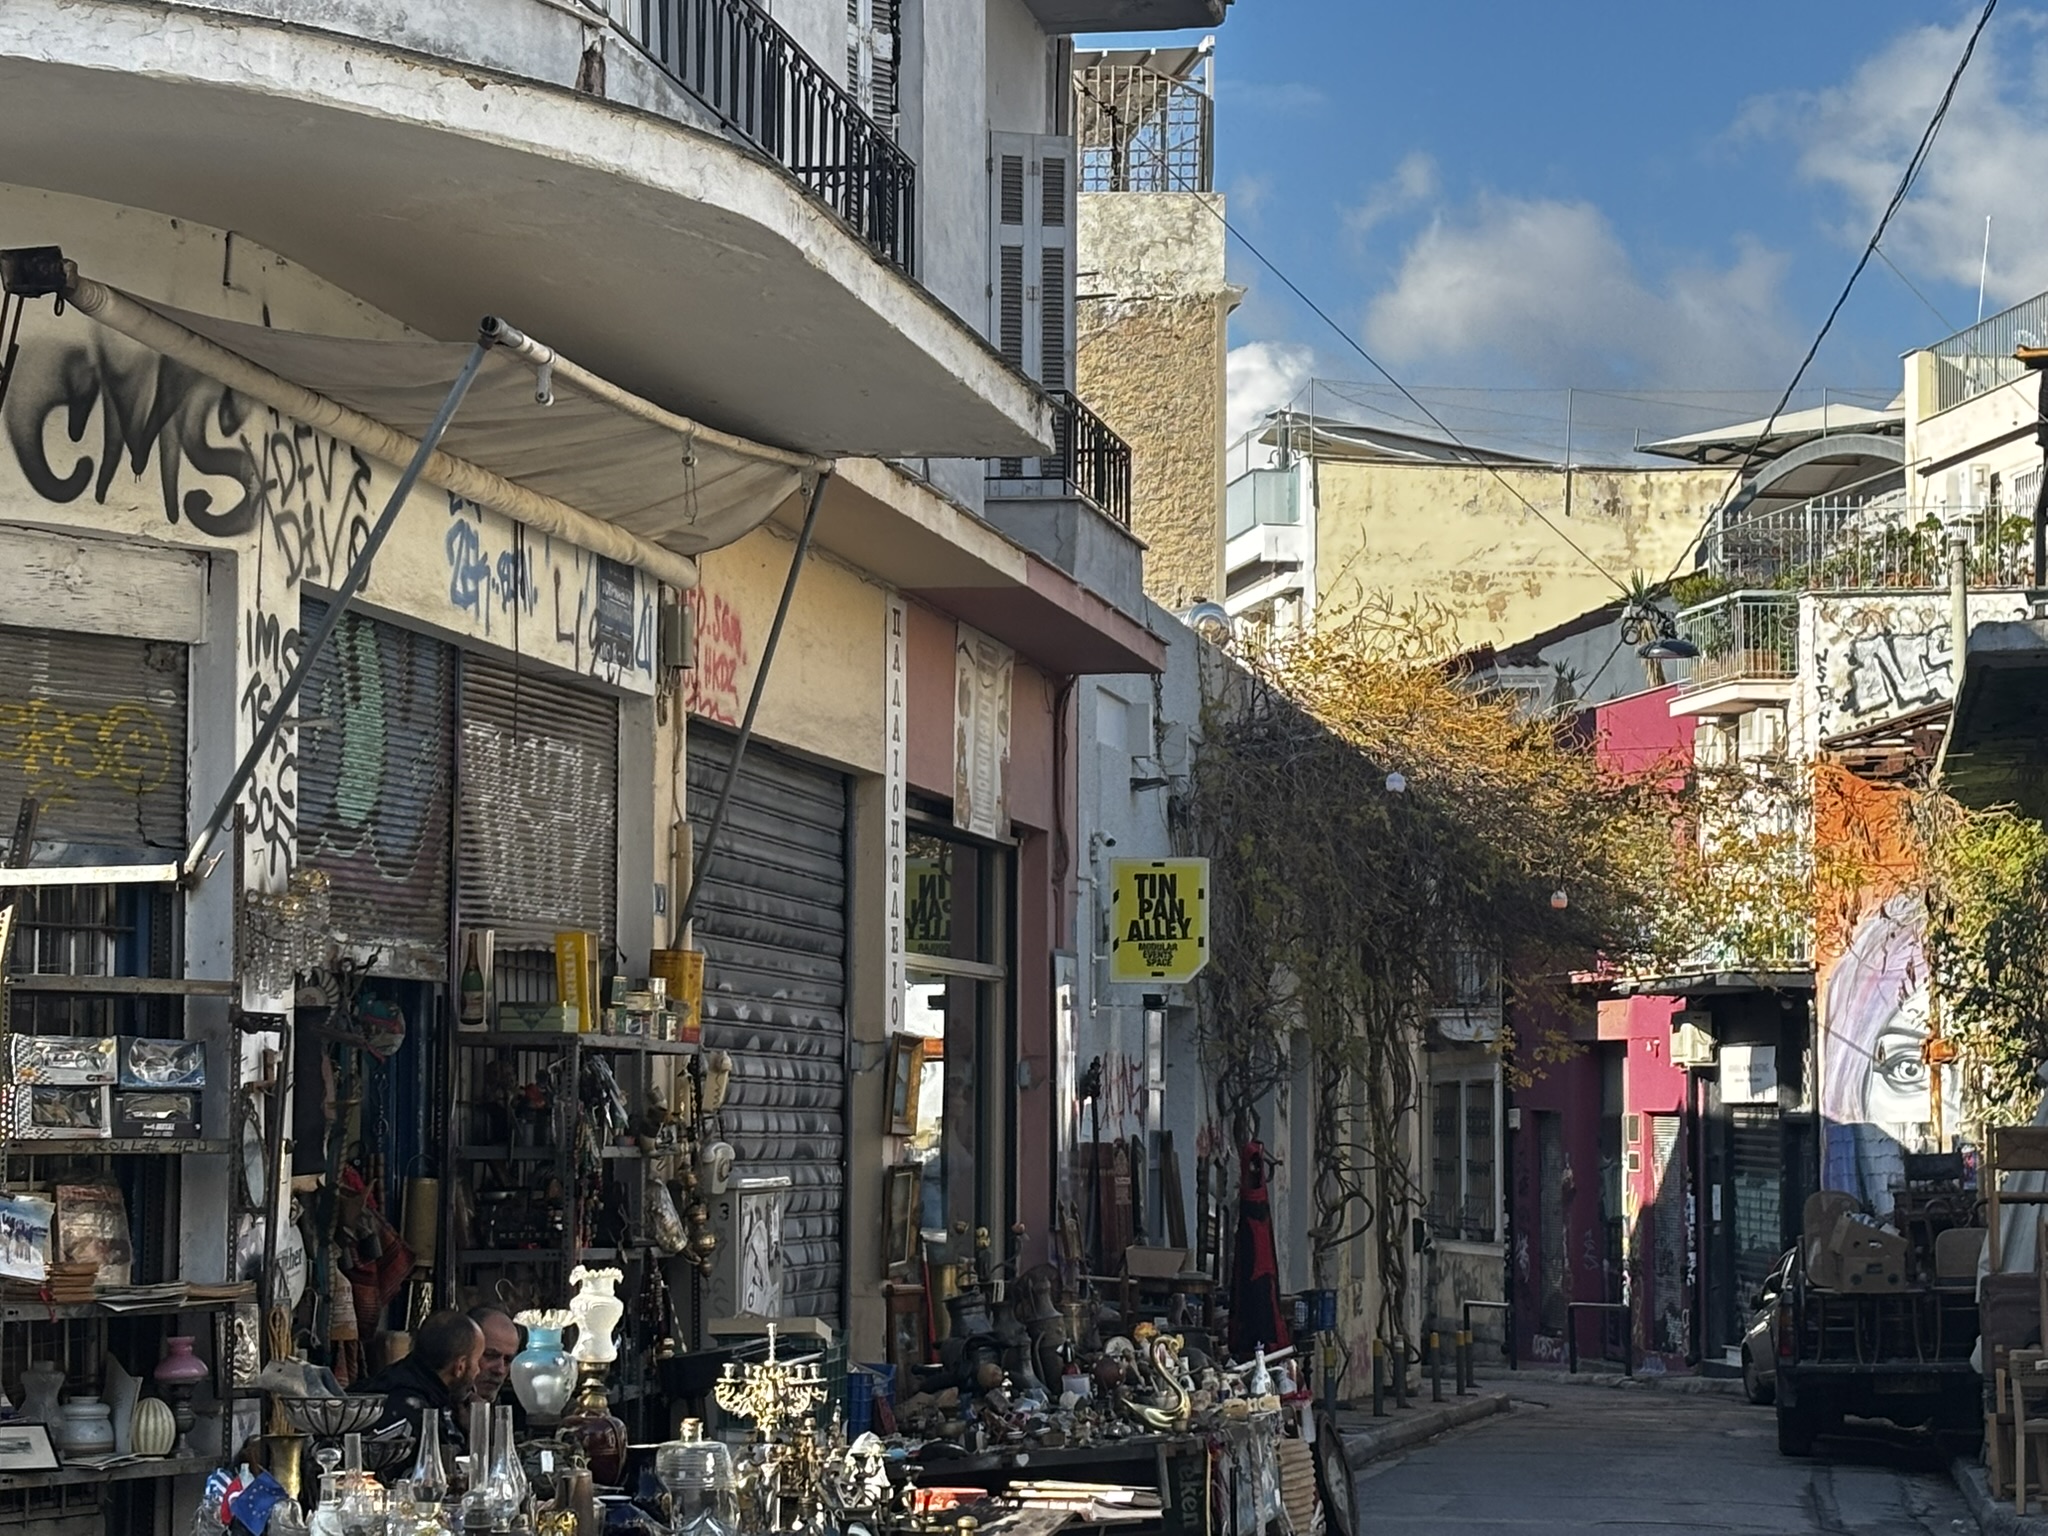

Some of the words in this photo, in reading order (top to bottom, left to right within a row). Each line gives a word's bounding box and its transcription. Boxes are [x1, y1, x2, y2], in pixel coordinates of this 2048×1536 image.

[1134, 873, 1177, 899] TIN
[1138, 898, 1185, 920] PAN
[1127, 917, 1193, 941] ALLEY
[1146, 959, 1172, 967] SPACE
